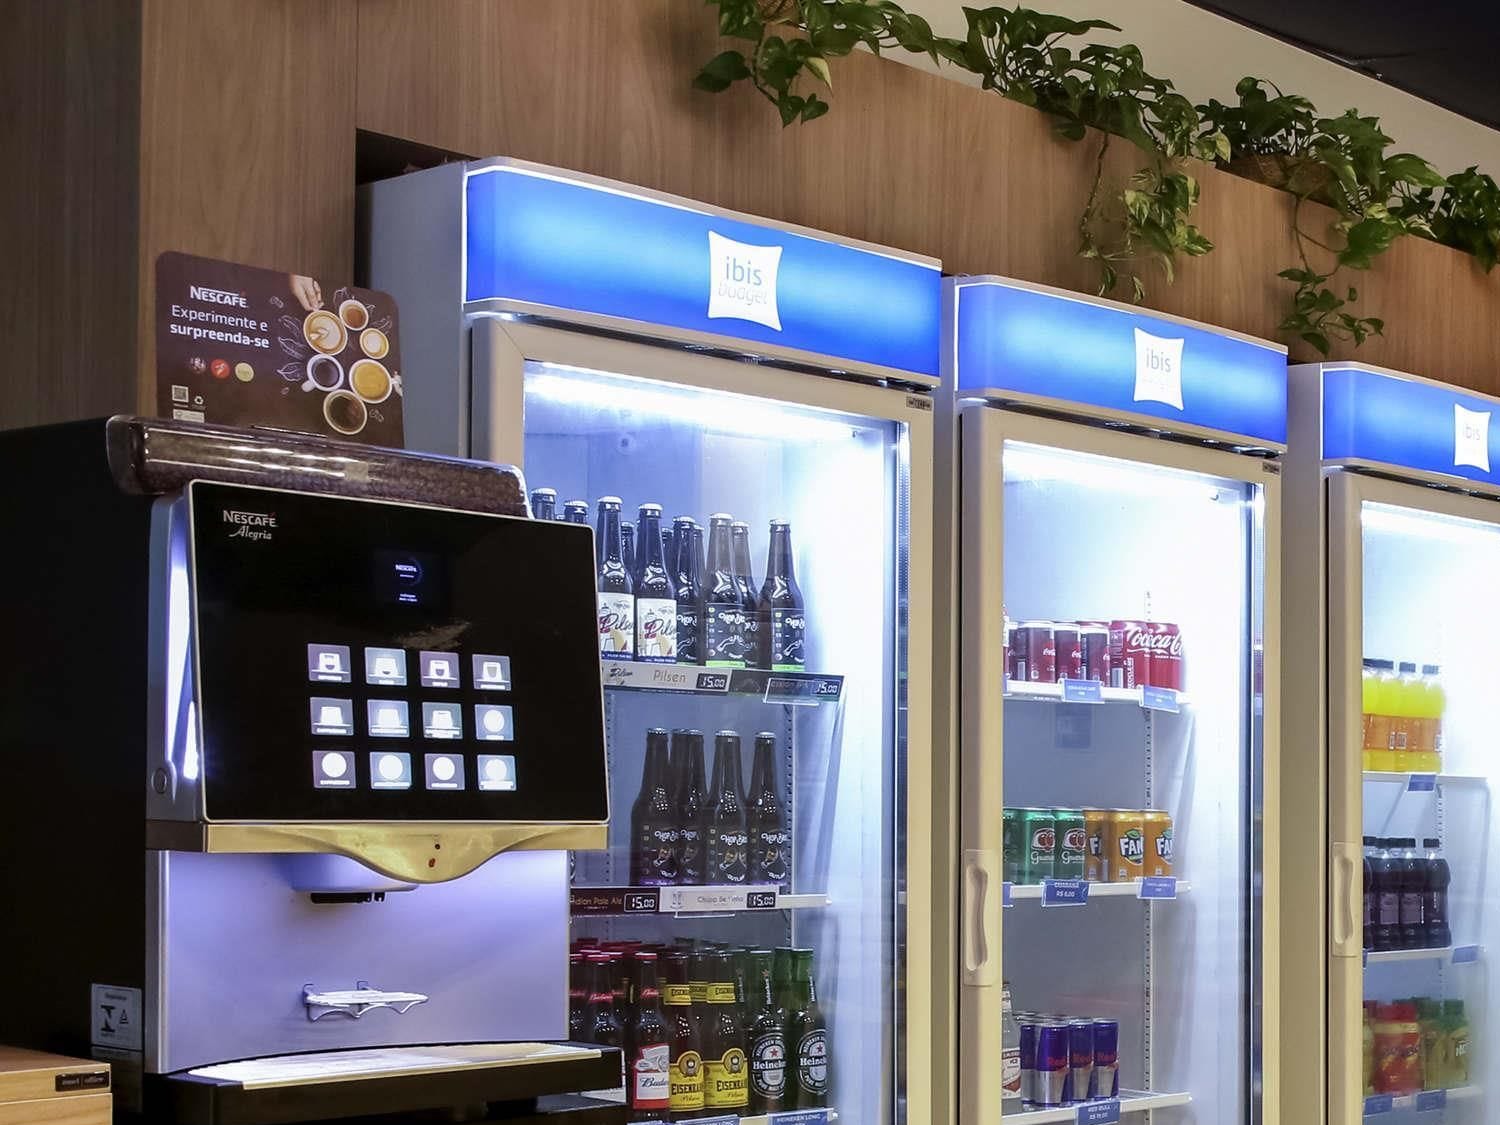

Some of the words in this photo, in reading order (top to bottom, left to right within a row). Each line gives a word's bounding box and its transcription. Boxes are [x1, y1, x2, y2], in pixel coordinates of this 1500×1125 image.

[726, 256, 762, 286] ibis
[171, 305, 257, 330] Experimente
[260, 322, 268, 332] e
[170, 323, 270, 348] surpreenda-se
[1146, 347, 1171, 373] ibis
[229, 526, 272, 541] Alegria
[653, 669, 687, 683] Pilsen
